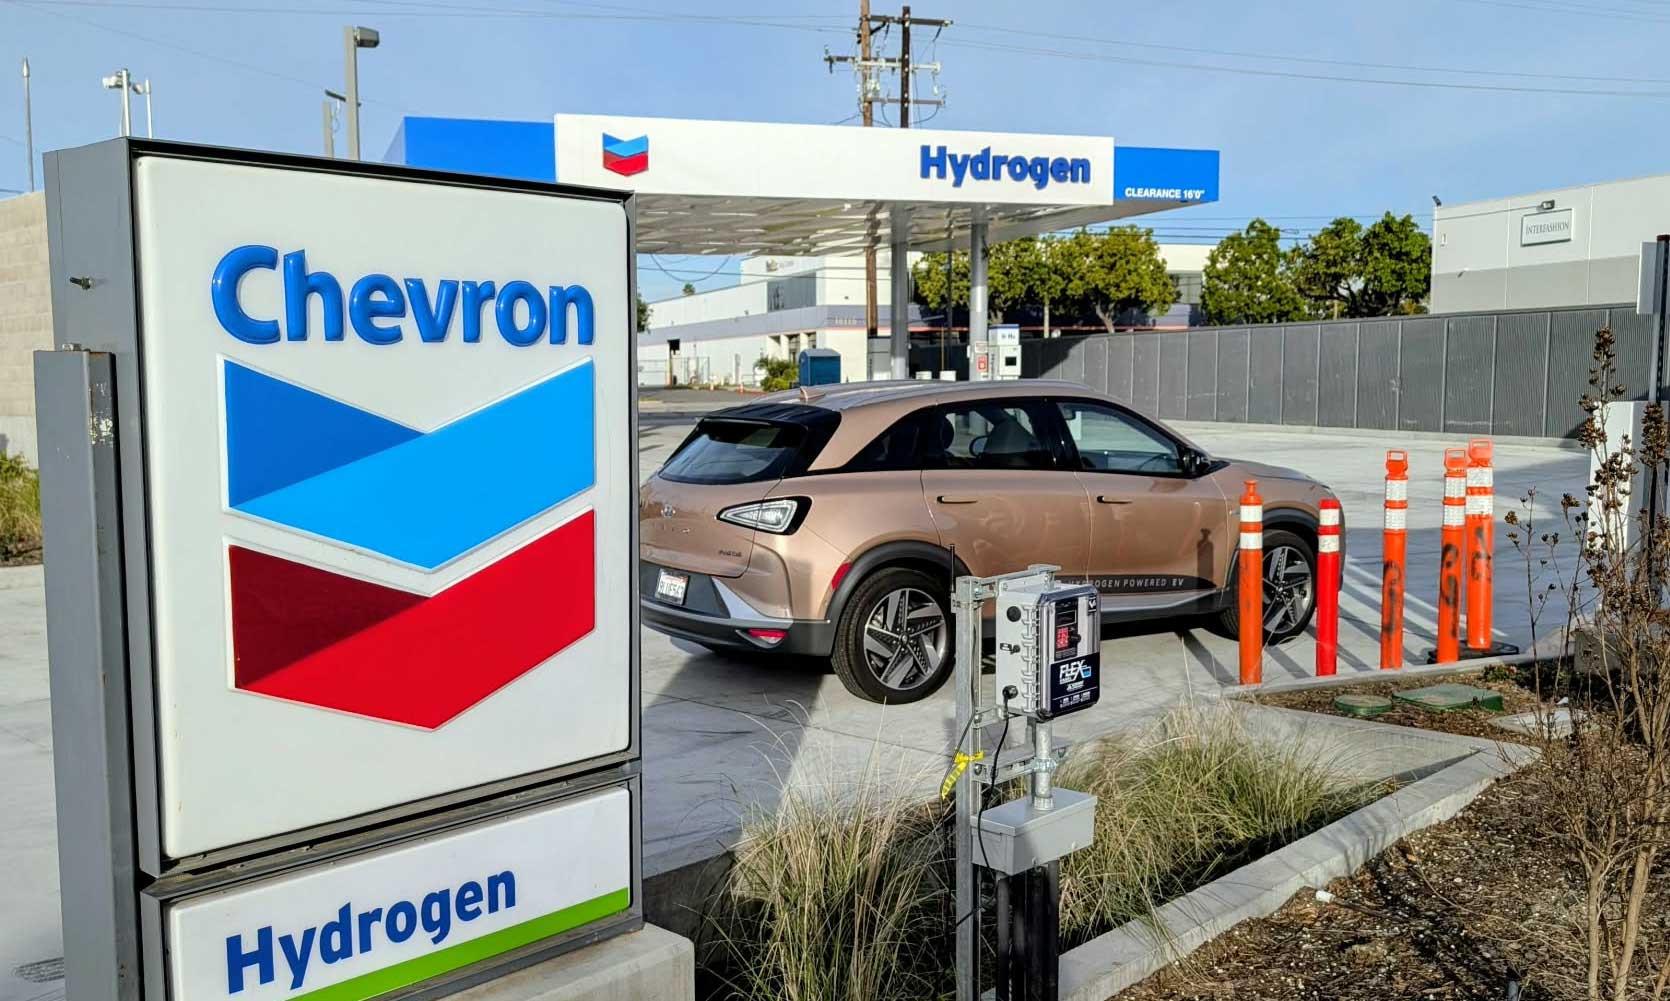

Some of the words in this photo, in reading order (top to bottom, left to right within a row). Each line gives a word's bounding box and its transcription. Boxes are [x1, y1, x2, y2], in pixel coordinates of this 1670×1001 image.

[920, 145, 1092, 190] Hydrogen
[1124, 187, 1182, 198] CLEARANCE
[1526, 221, 1569, 235] INTERFASHION
[211, 244, 594, 347] Chevron
[1122, 578, 1166, 588] POWERED
[1171, 578, 1184, 587] EV
[1059, 659, 1086, 682] FLEX
[226, 870, 516, 994] Hydrogen
